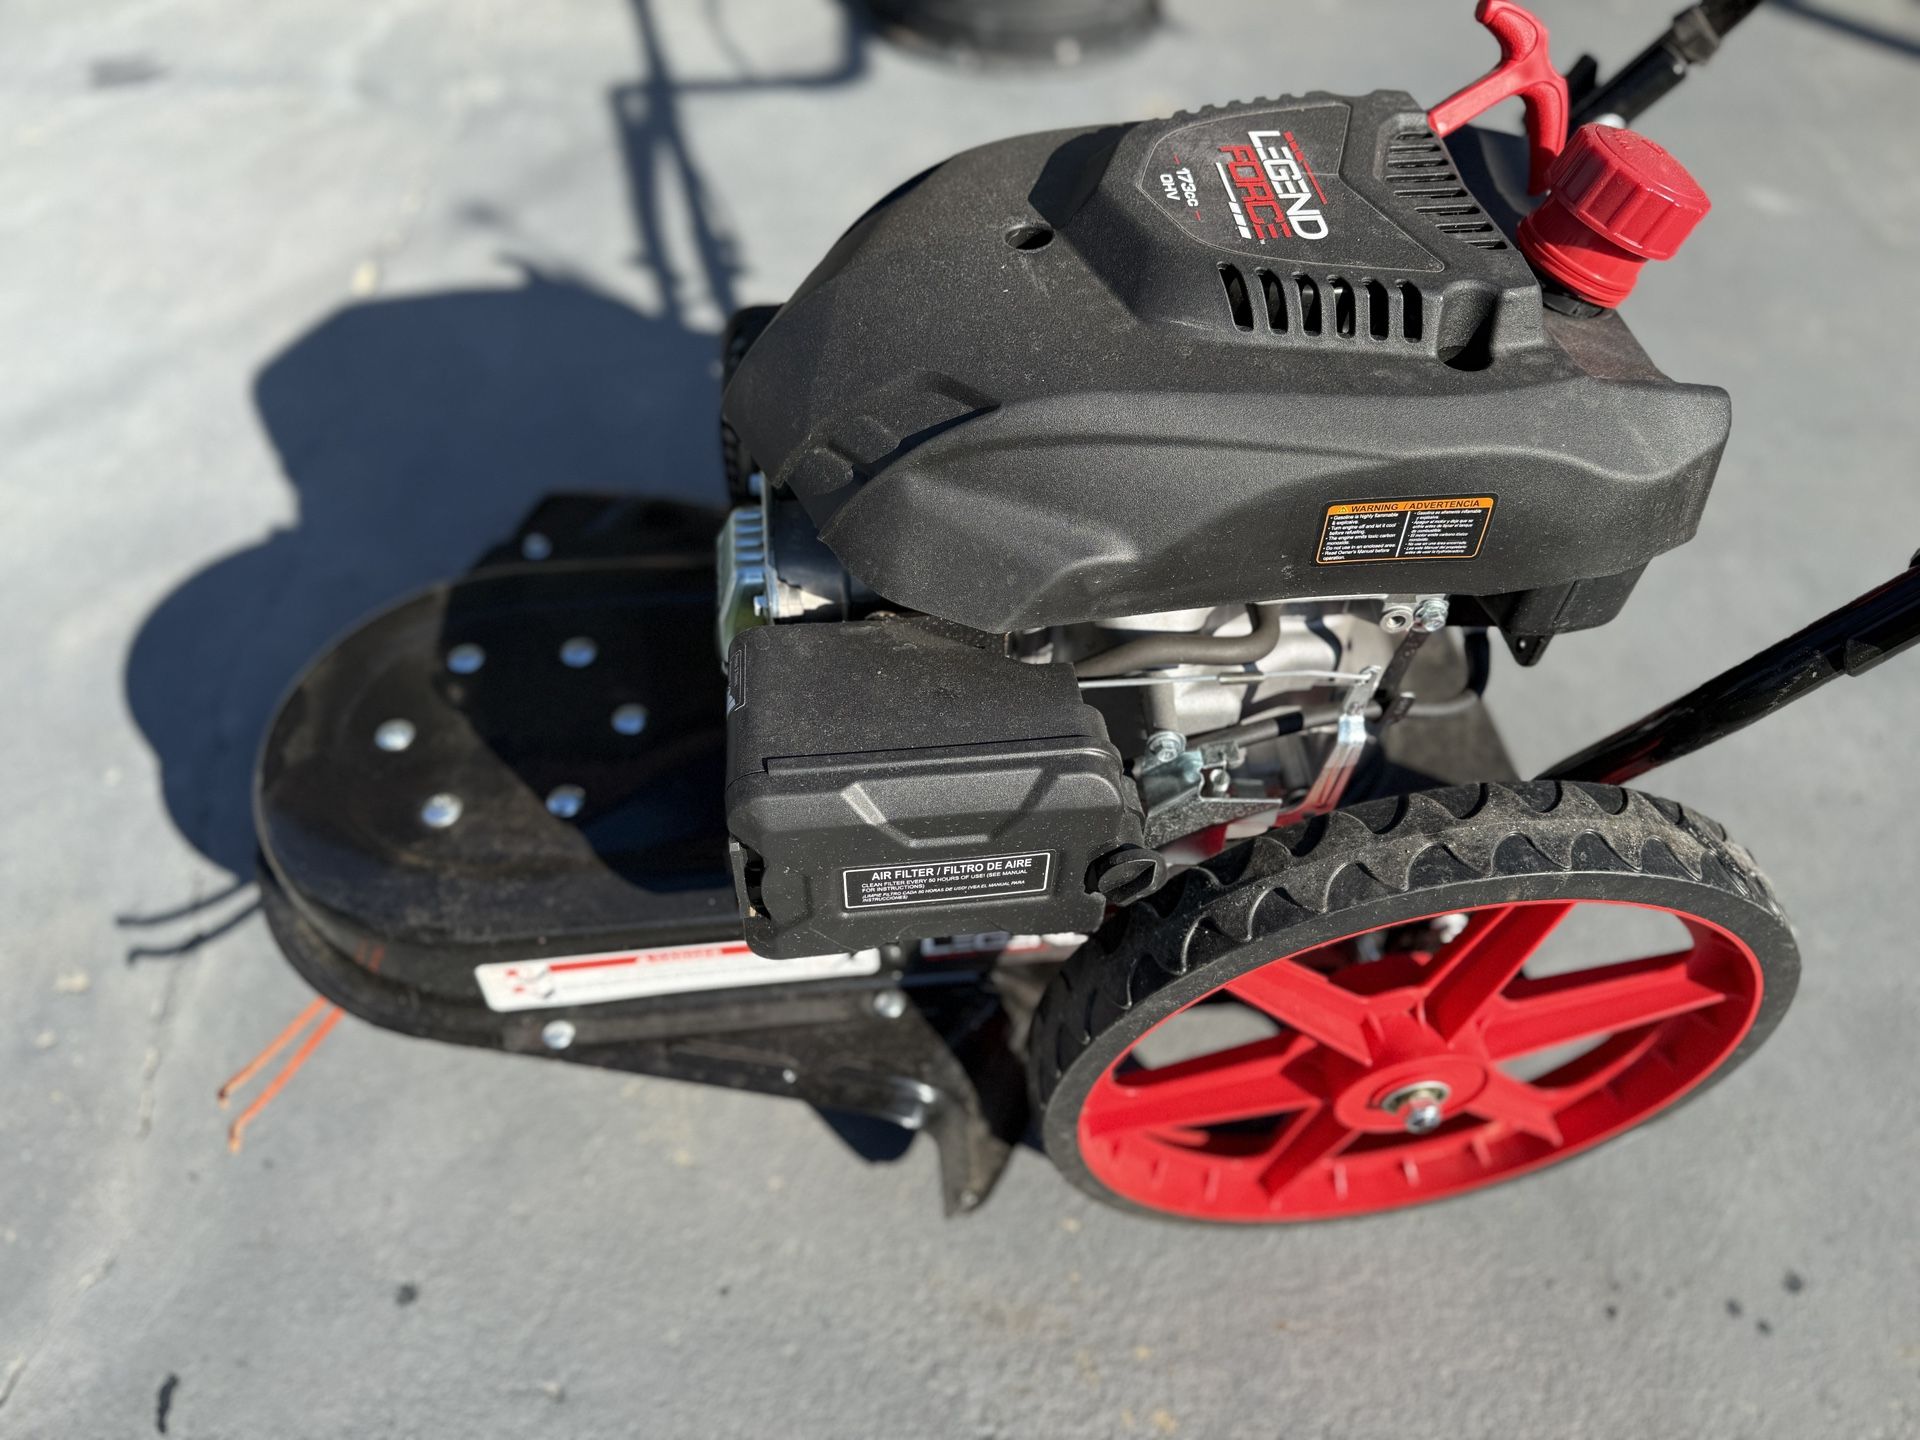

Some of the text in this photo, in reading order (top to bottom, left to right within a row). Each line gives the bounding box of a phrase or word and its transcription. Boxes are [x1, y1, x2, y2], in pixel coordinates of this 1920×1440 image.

[1160, 173, 1180, 200] OHV
[1176, 167, 1198, 207] 173cc
[1218, 144, 1292, 240] FORCE
[1248, 131, 1328, 240] LEGEND
[1352, 504, 1398, 512] WARNING
[1408, 500, 1480, 510] ADVERTENCIA
[872, 870, 892, 880] AIR
[895, 867, 934, 879] FILTER
[943, 864, 984, 874] FILTRO
[987, 861, 1002, 870] DE
[1005, 858, 1032, 869] AIRE
[877, 883, 925, 892] INSTRUCTIONS)
